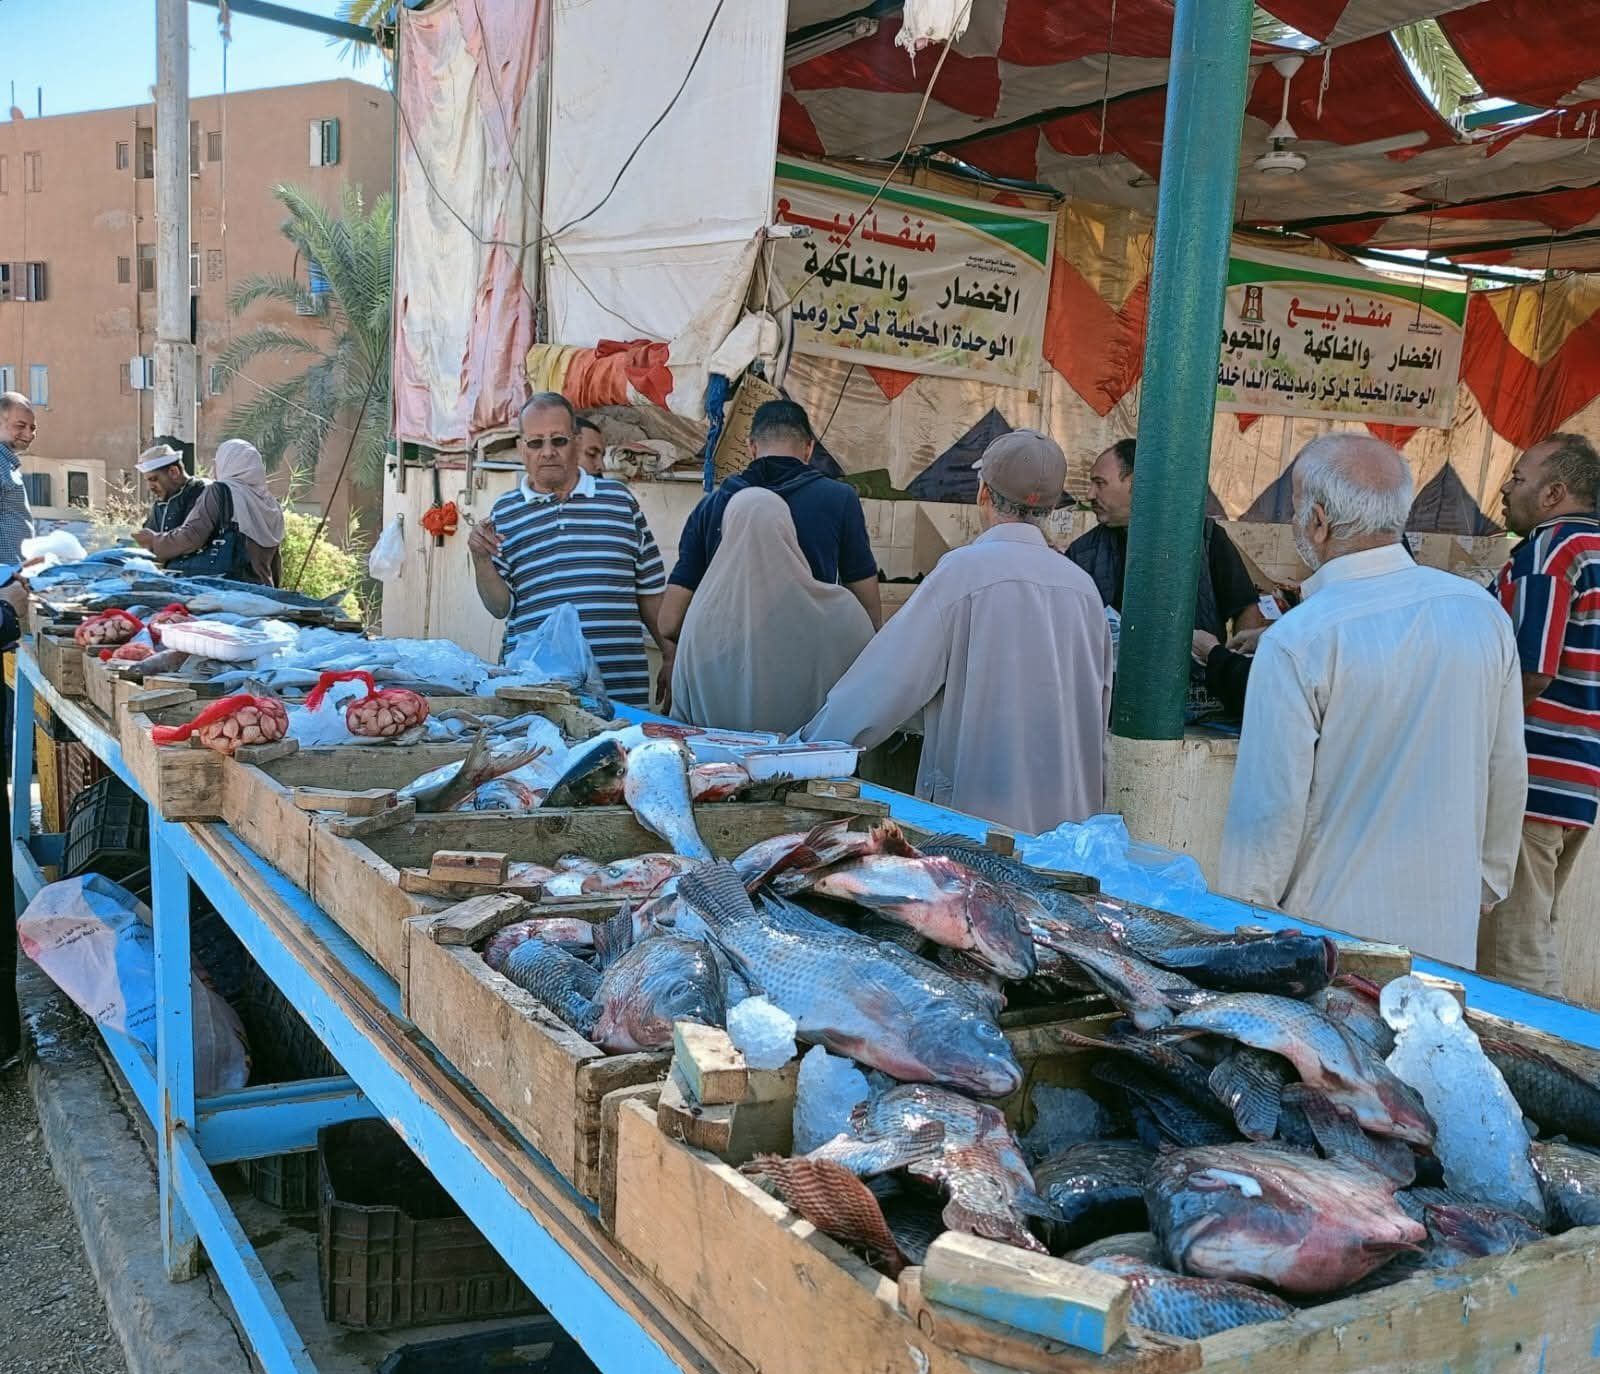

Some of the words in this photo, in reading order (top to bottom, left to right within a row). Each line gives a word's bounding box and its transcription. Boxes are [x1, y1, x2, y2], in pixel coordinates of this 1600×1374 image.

[861, 207, 936, 252] منفذ
[803, 241, 908, 302] والفاكهة
[936, 276, 1020, 315] الخضار
[1342, 297, 1392, 328] منفذ
[830, 303, 880, 339] لمركز
[886, 310, 947, 348] المحلية
[1287, 297, 1340, 331] بيع
[951, 325, 1014, 361] الوحدة
[1221, 327, 1281, 359] واللحوم
[1304, 329, 1370, 369] والفاكهة
[1387, 344, 1442, 372] الخضار
[1272, 368, 1317, 400] ومدينة
[1318, 376, 1350, 401] لمركز
[1353, 377, 1394, 405] المحلية
[1394, 383, 1436, 409] الوحدة
